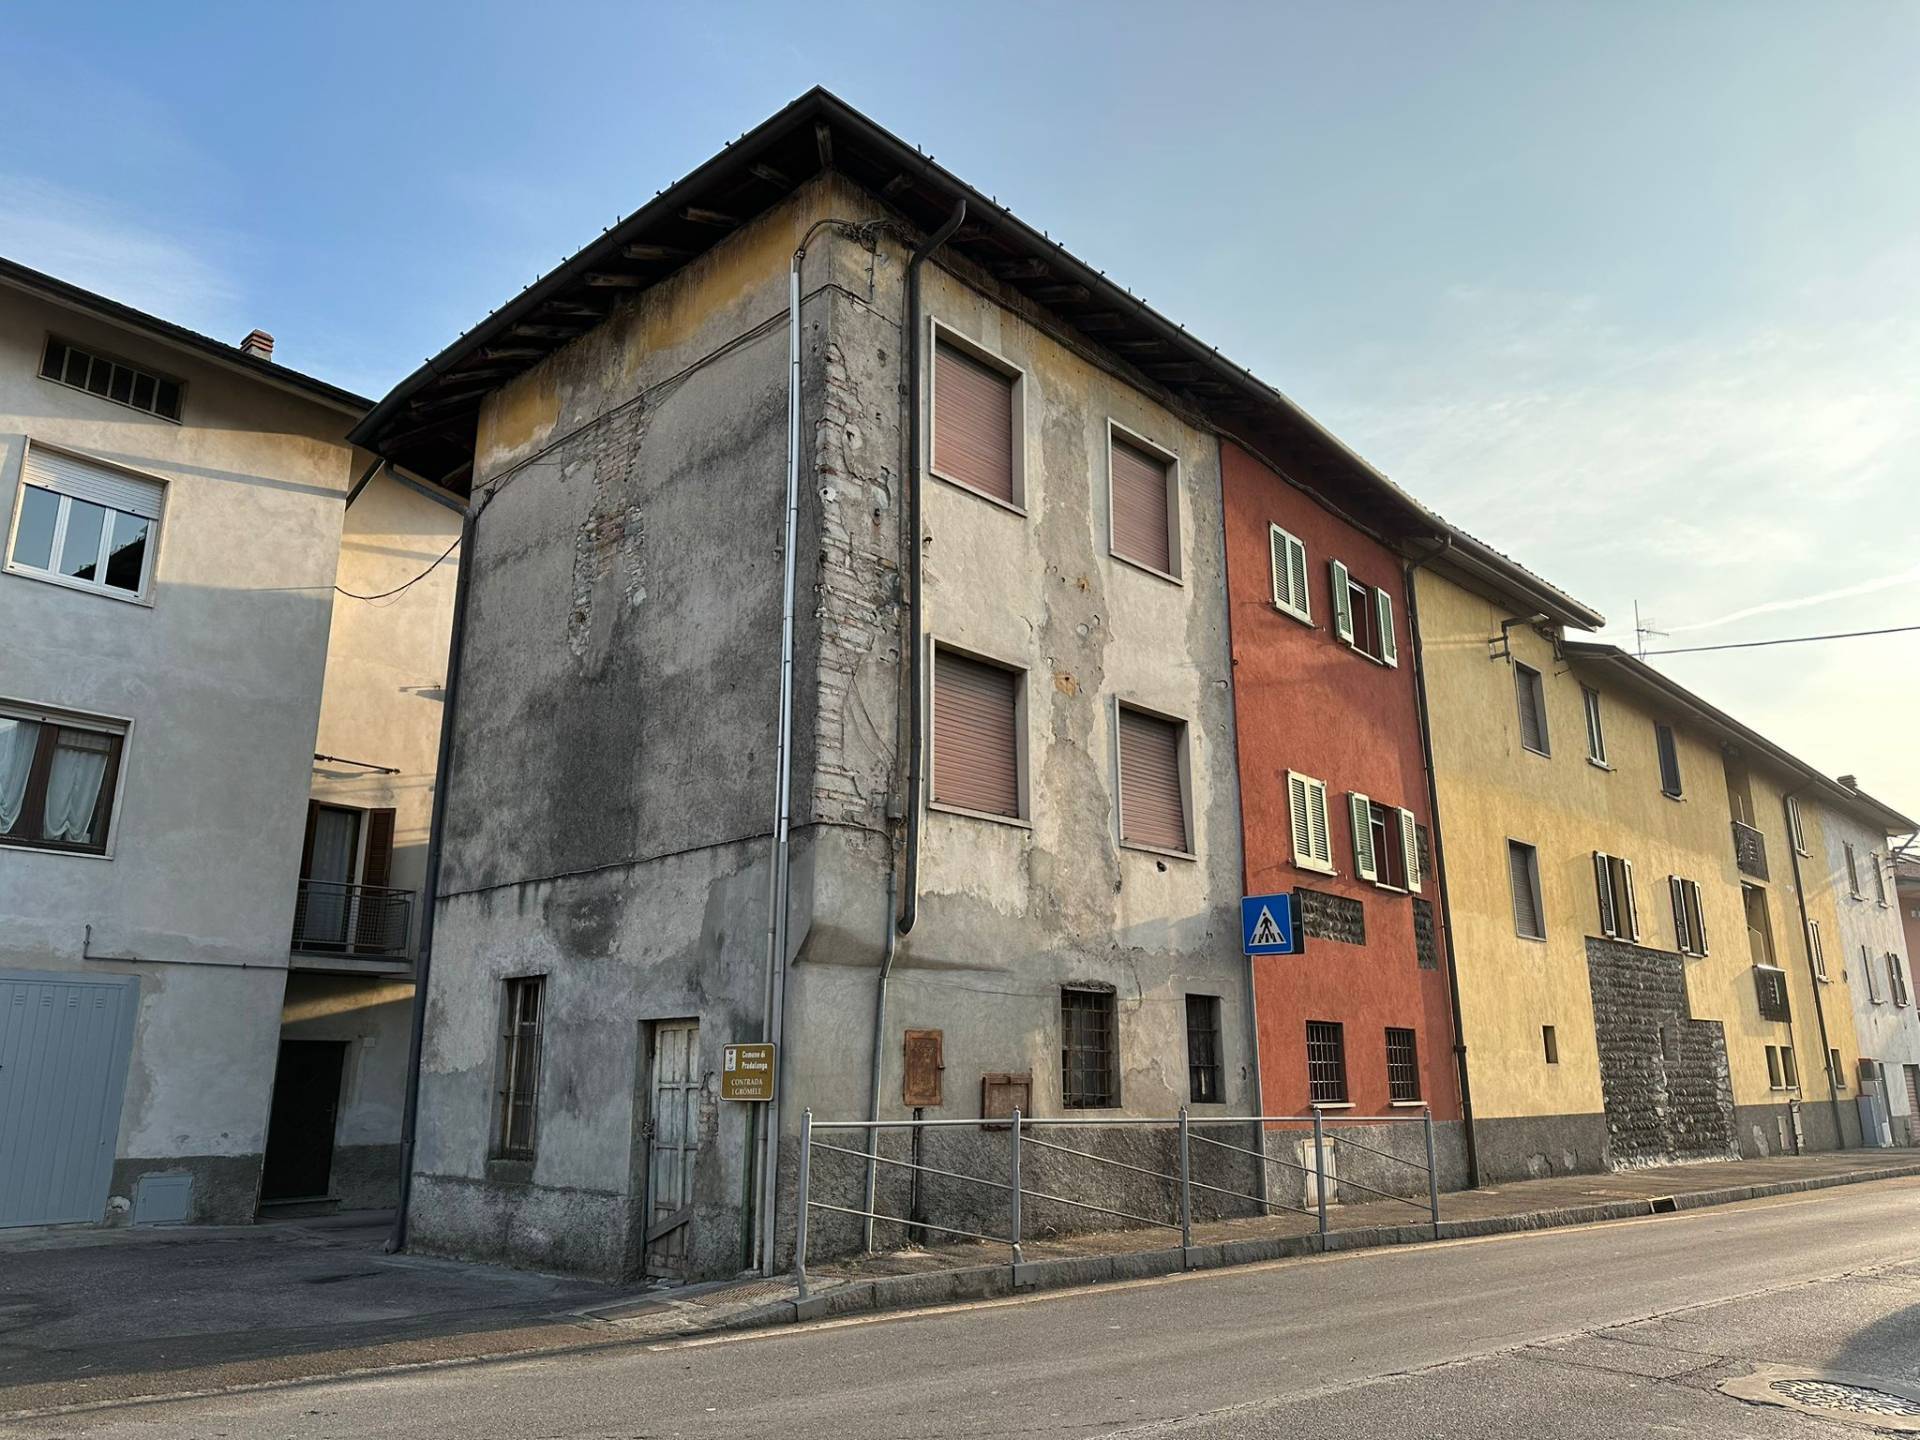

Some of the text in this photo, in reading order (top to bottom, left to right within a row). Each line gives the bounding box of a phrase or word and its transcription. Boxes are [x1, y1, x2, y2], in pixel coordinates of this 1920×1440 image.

[742, 1050, 766, 1058] Comune di
[741, 1061, 768, 1071] Pradalunga
[732, 1078, 763, 1086] CONTRADA
